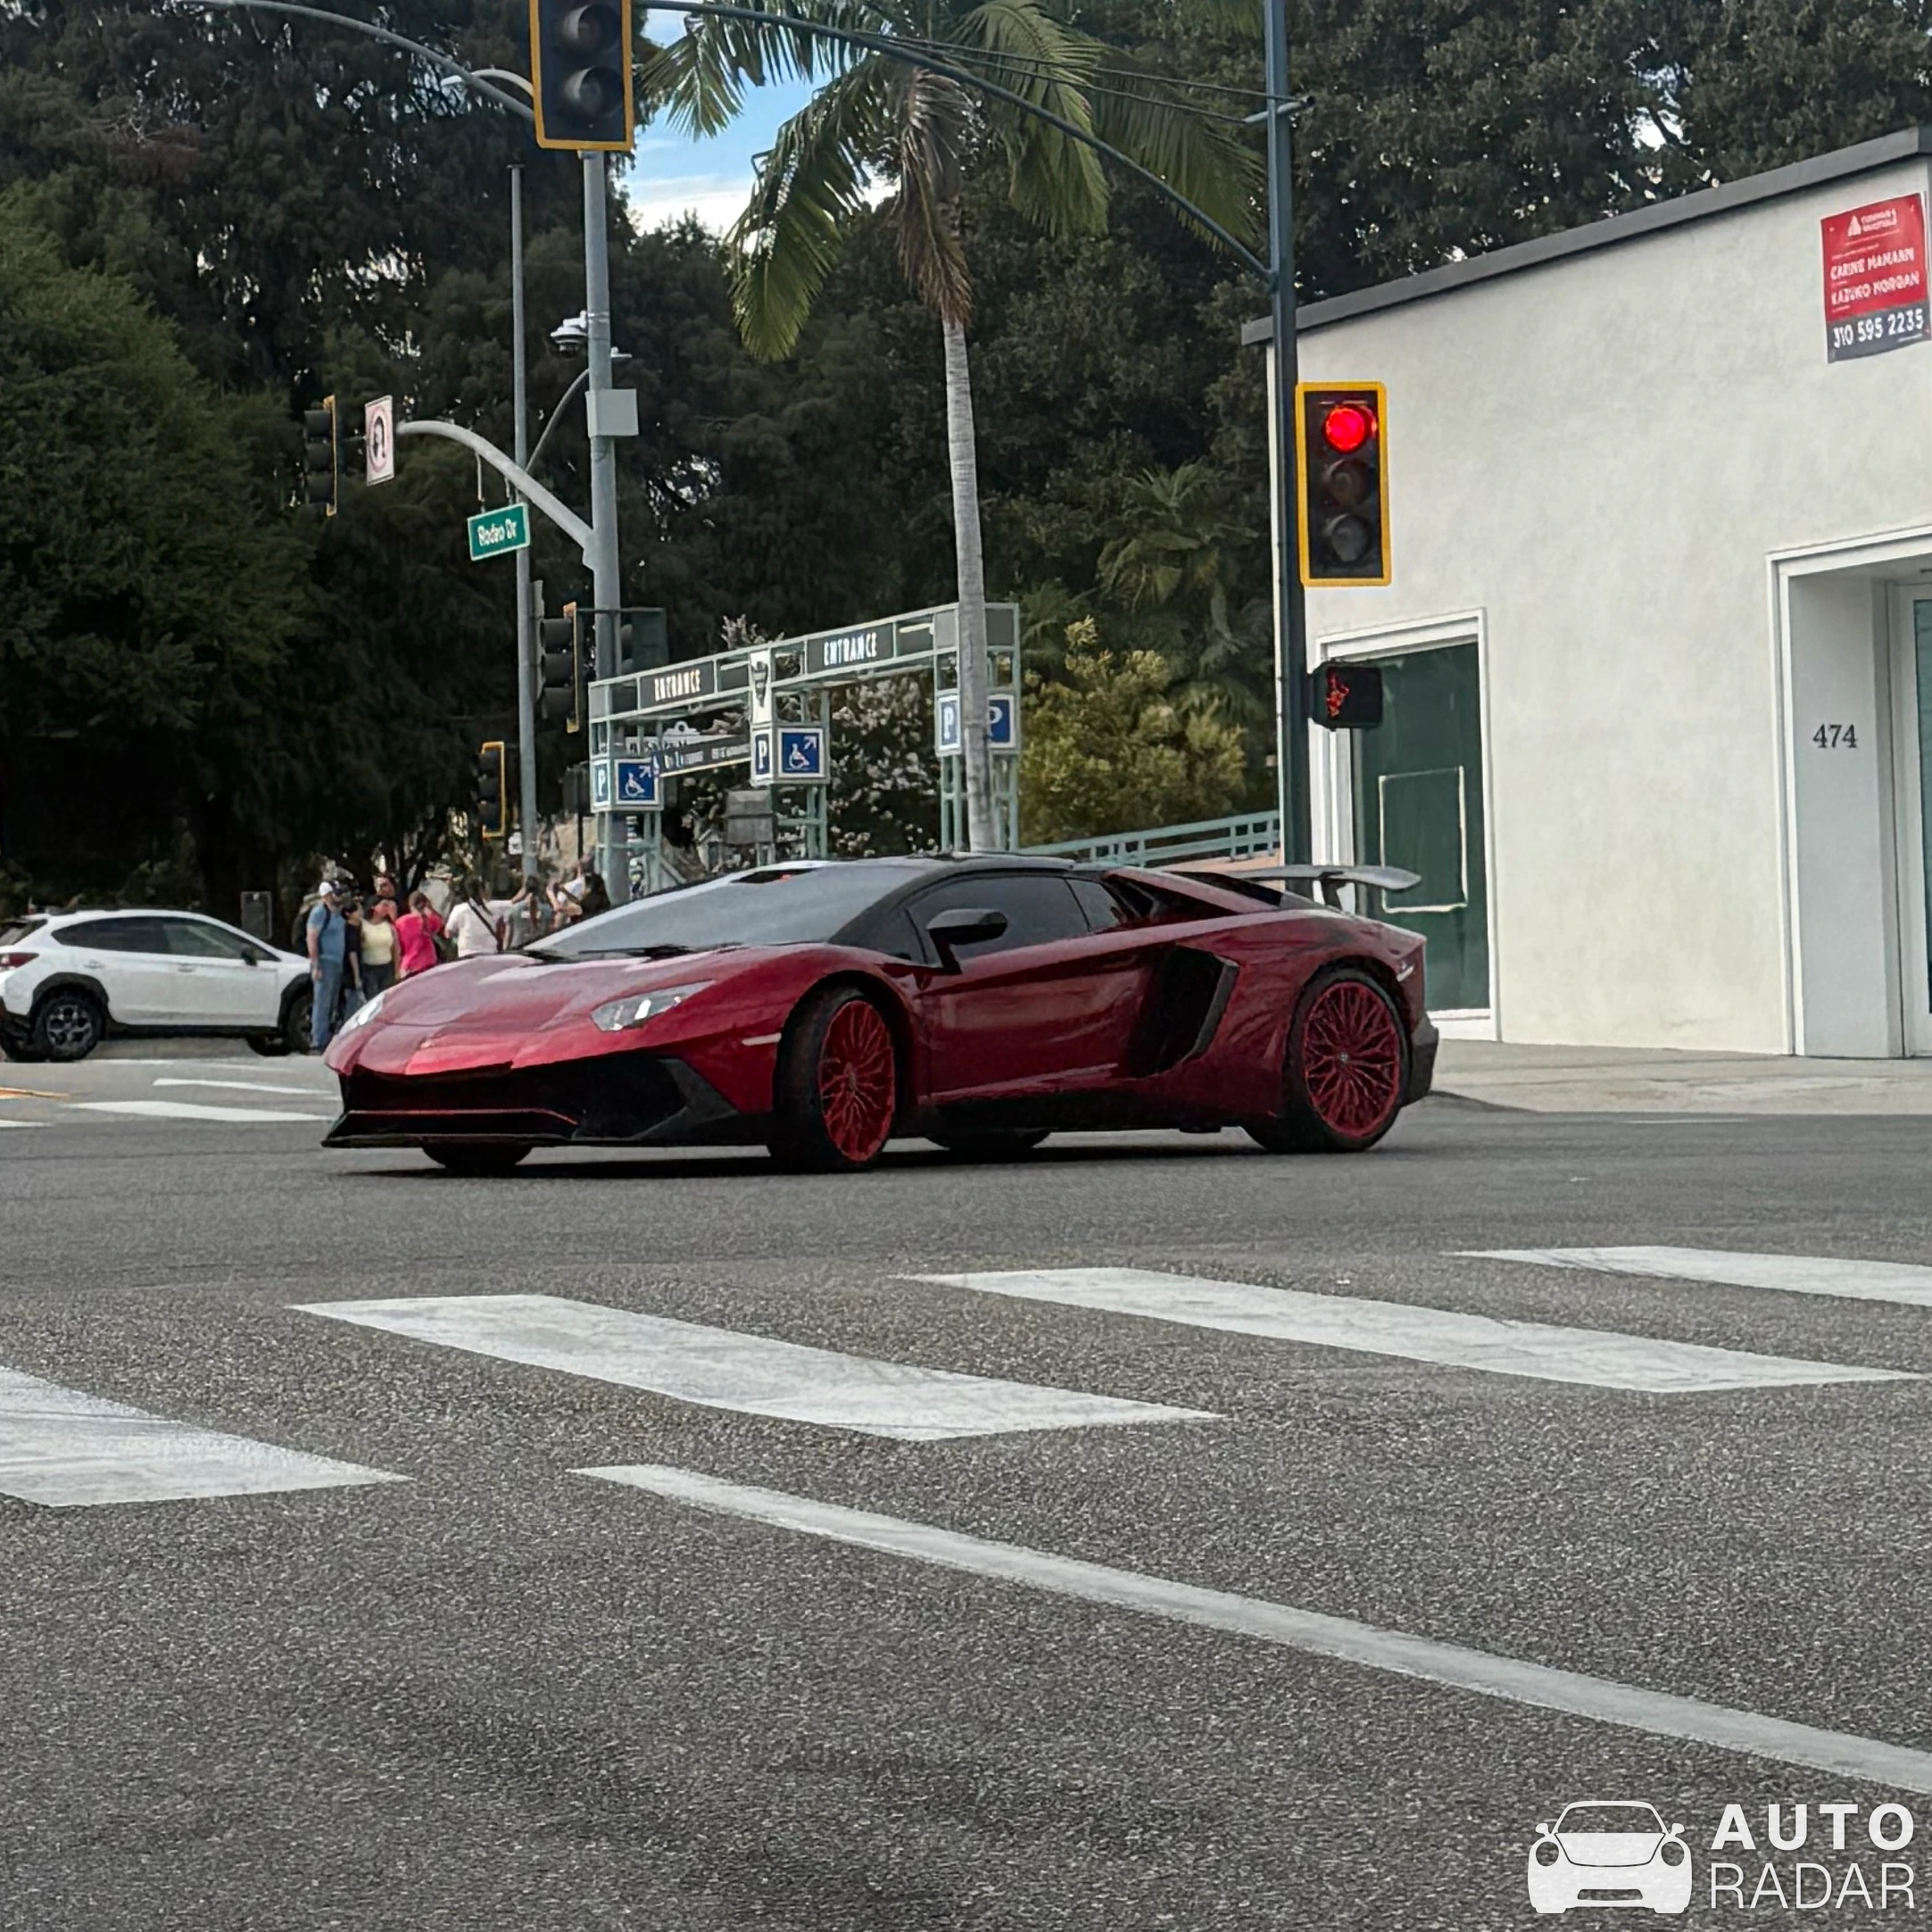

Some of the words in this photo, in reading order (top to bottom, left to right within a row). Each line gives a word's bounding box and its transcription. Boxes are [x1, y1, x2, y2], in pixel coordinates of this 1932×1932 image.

[1858, 317, 1884, 343] 595
[1887, 309, 1924, 336] 2235
[477, 523, 505, 547] Rodeo
[824, 632, 877, 667] ENTRANCE
[654, 668, 701, 701] ENTRANCE
[944, 706, 954, 740] P
[1812, 724, 1858, 749] 474
[758, 740, 768, 769] P
